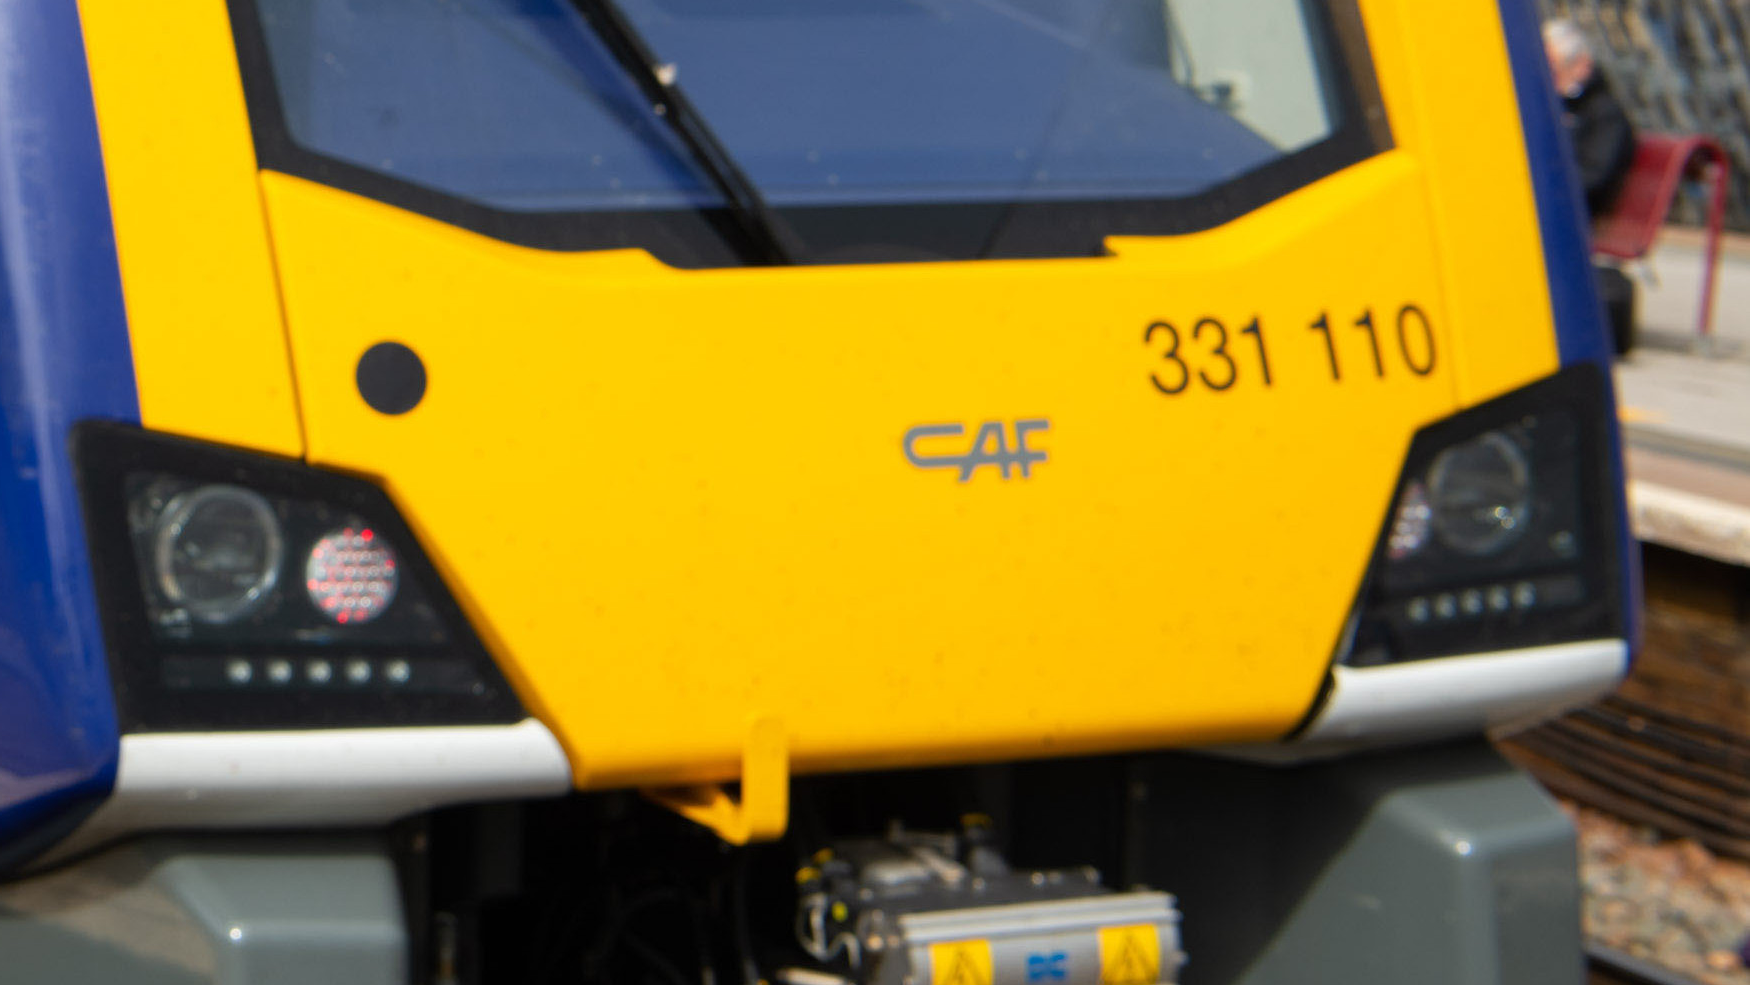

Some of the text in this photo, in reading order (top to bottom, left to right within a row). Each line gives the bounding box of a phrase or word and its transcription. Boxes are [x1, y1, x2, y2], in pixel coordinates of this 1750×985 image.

[1144, 304, 1436, 395] 331 110
[902, 418, 1051, 483] CAF
